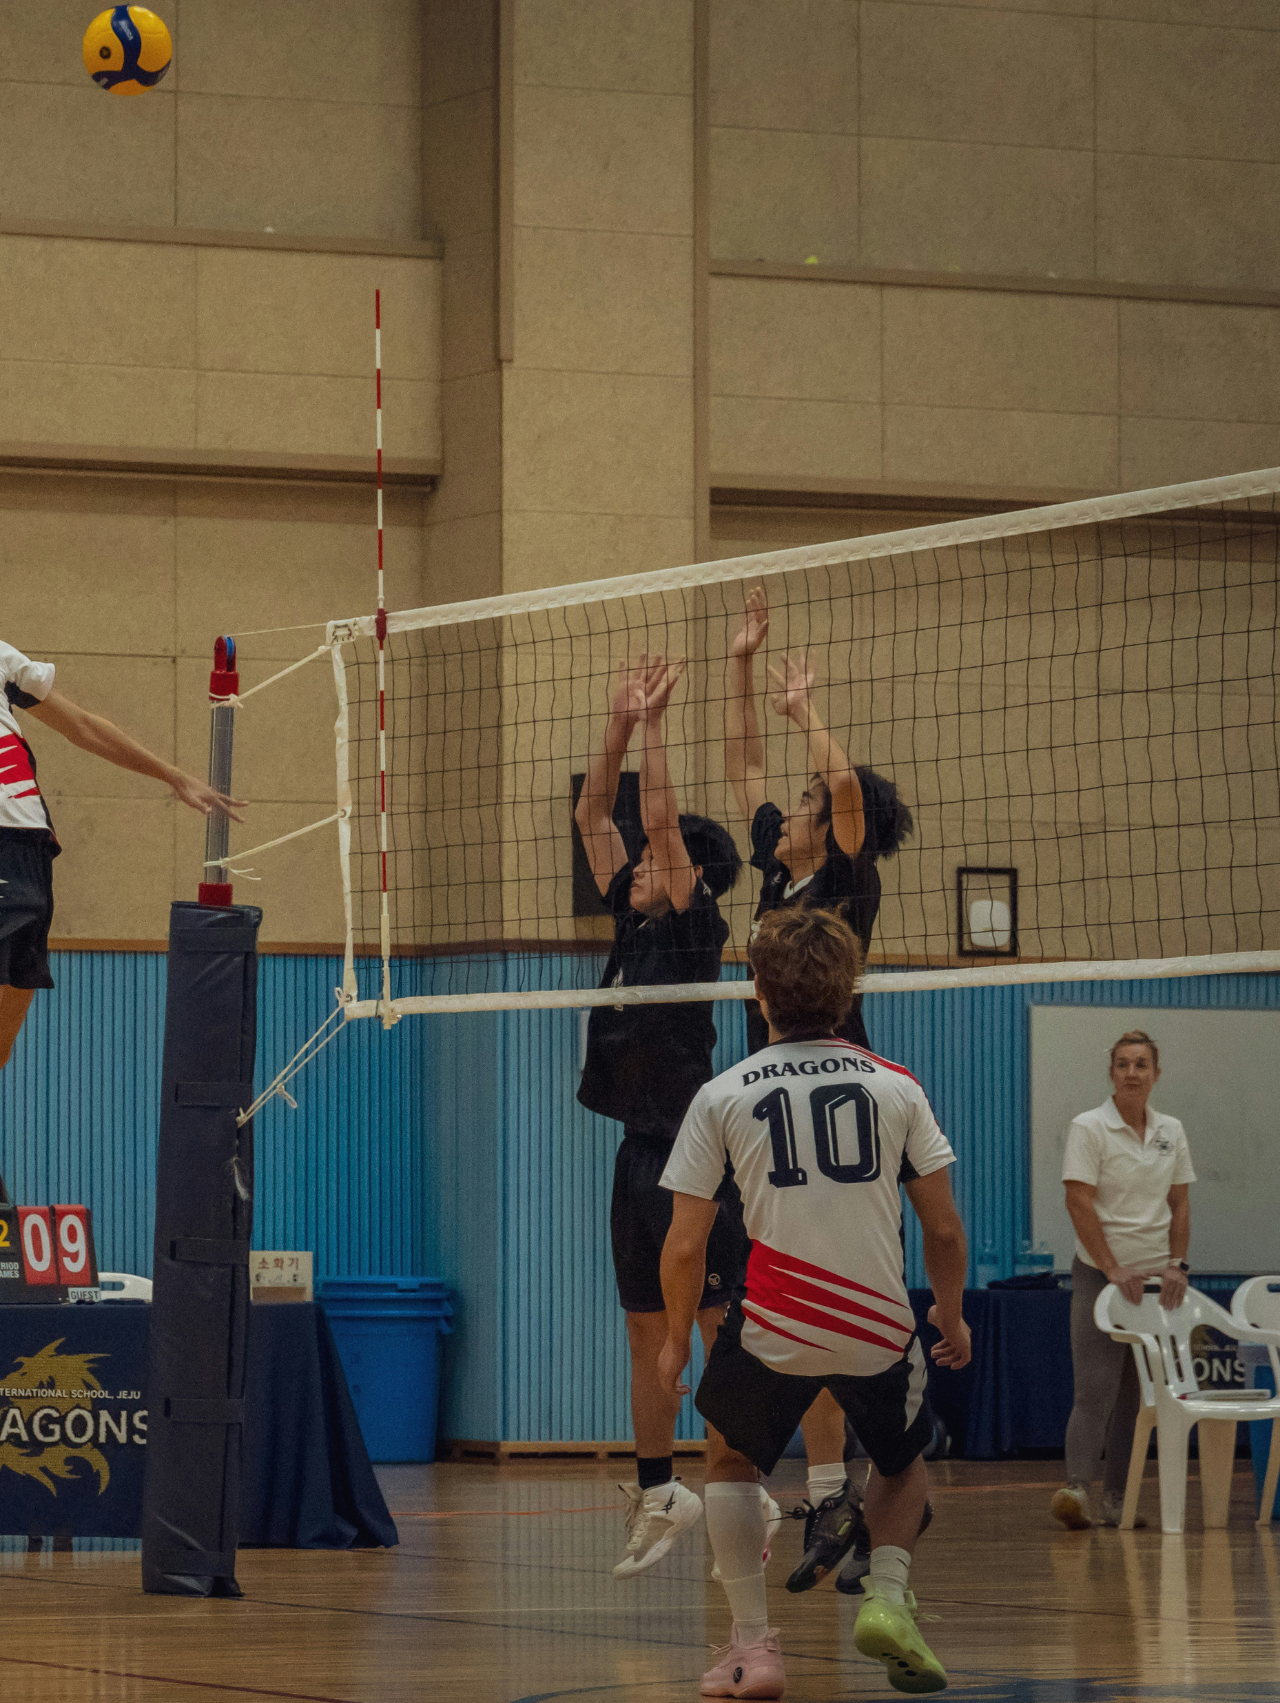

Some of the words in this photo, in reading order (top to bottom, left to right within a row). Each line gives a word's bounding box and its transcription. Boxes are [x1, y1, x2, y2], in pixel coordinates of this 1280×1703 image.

[742, 1057, 876, 1087] DRAGONS
[752, 1082, 882, 1189] 10
[258, 1257, 300, 1271] 소화기
[70, 1290, 99, 1300] GUEST
[116, 1390, 141, 1399] JEJU
